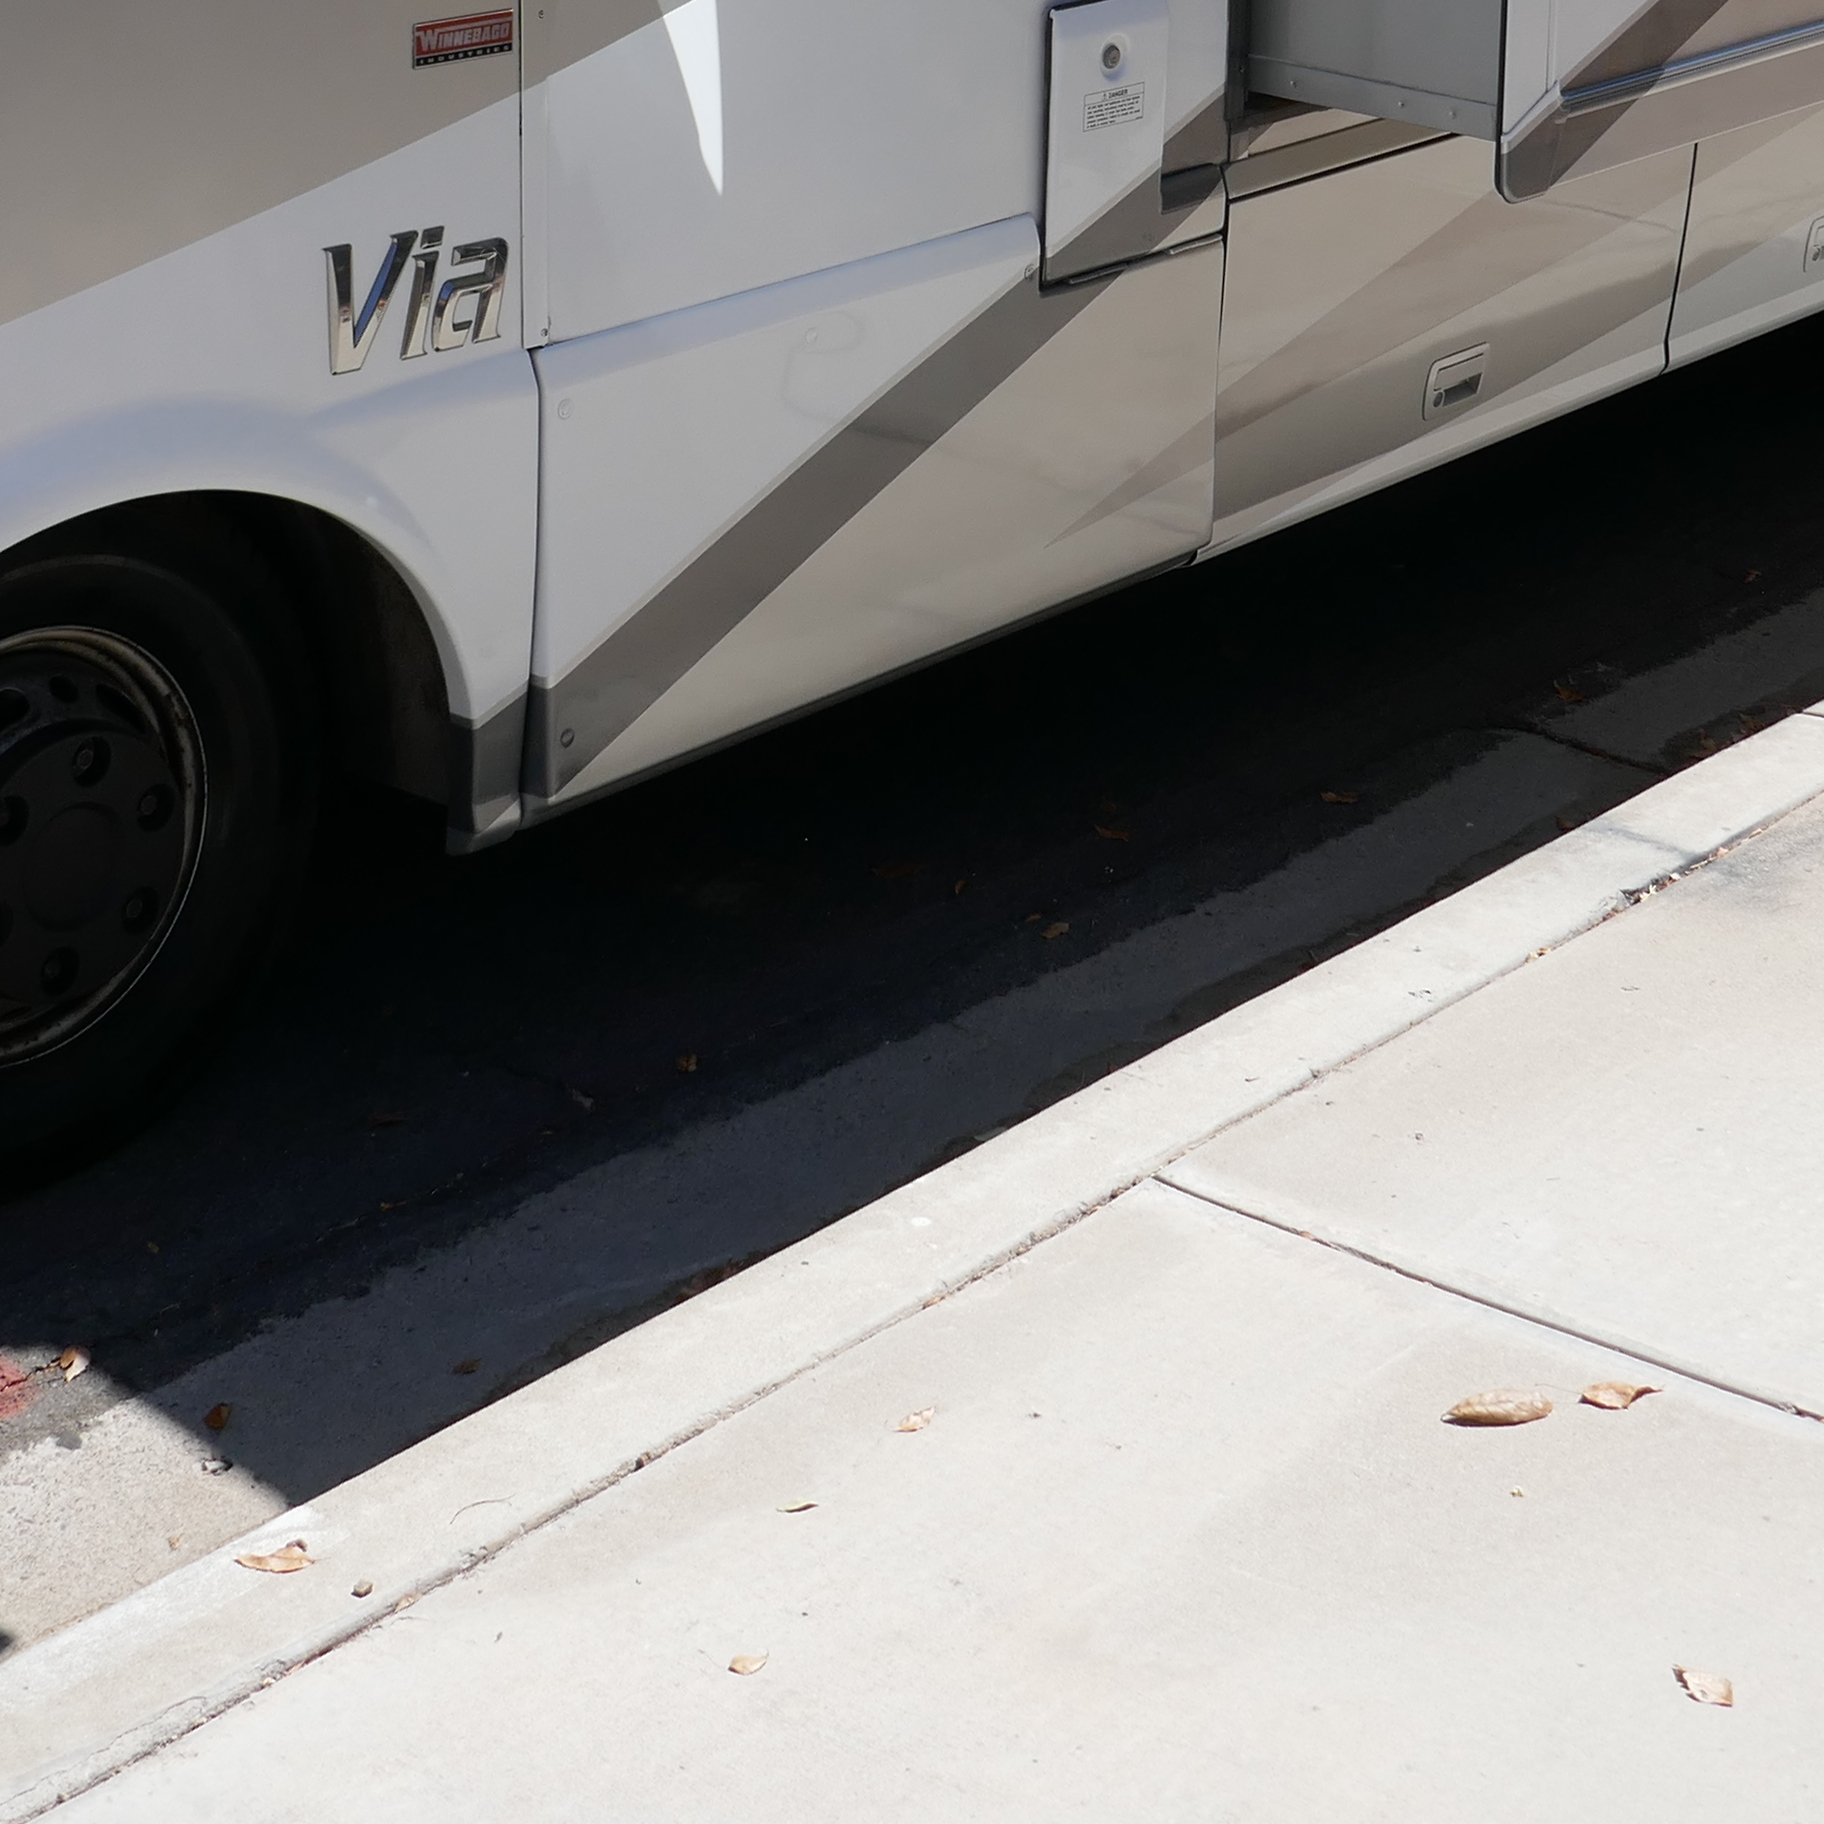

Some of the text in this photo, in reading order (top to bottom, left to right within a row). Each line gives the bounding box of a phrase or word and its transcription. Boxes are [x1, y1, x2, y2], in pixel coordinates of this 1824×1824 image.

[416, 21, 510, 52] WINNEBAGO
[419, 44, 510, 65] INDUSTRIES
[322, 224, 509, 376] Via
